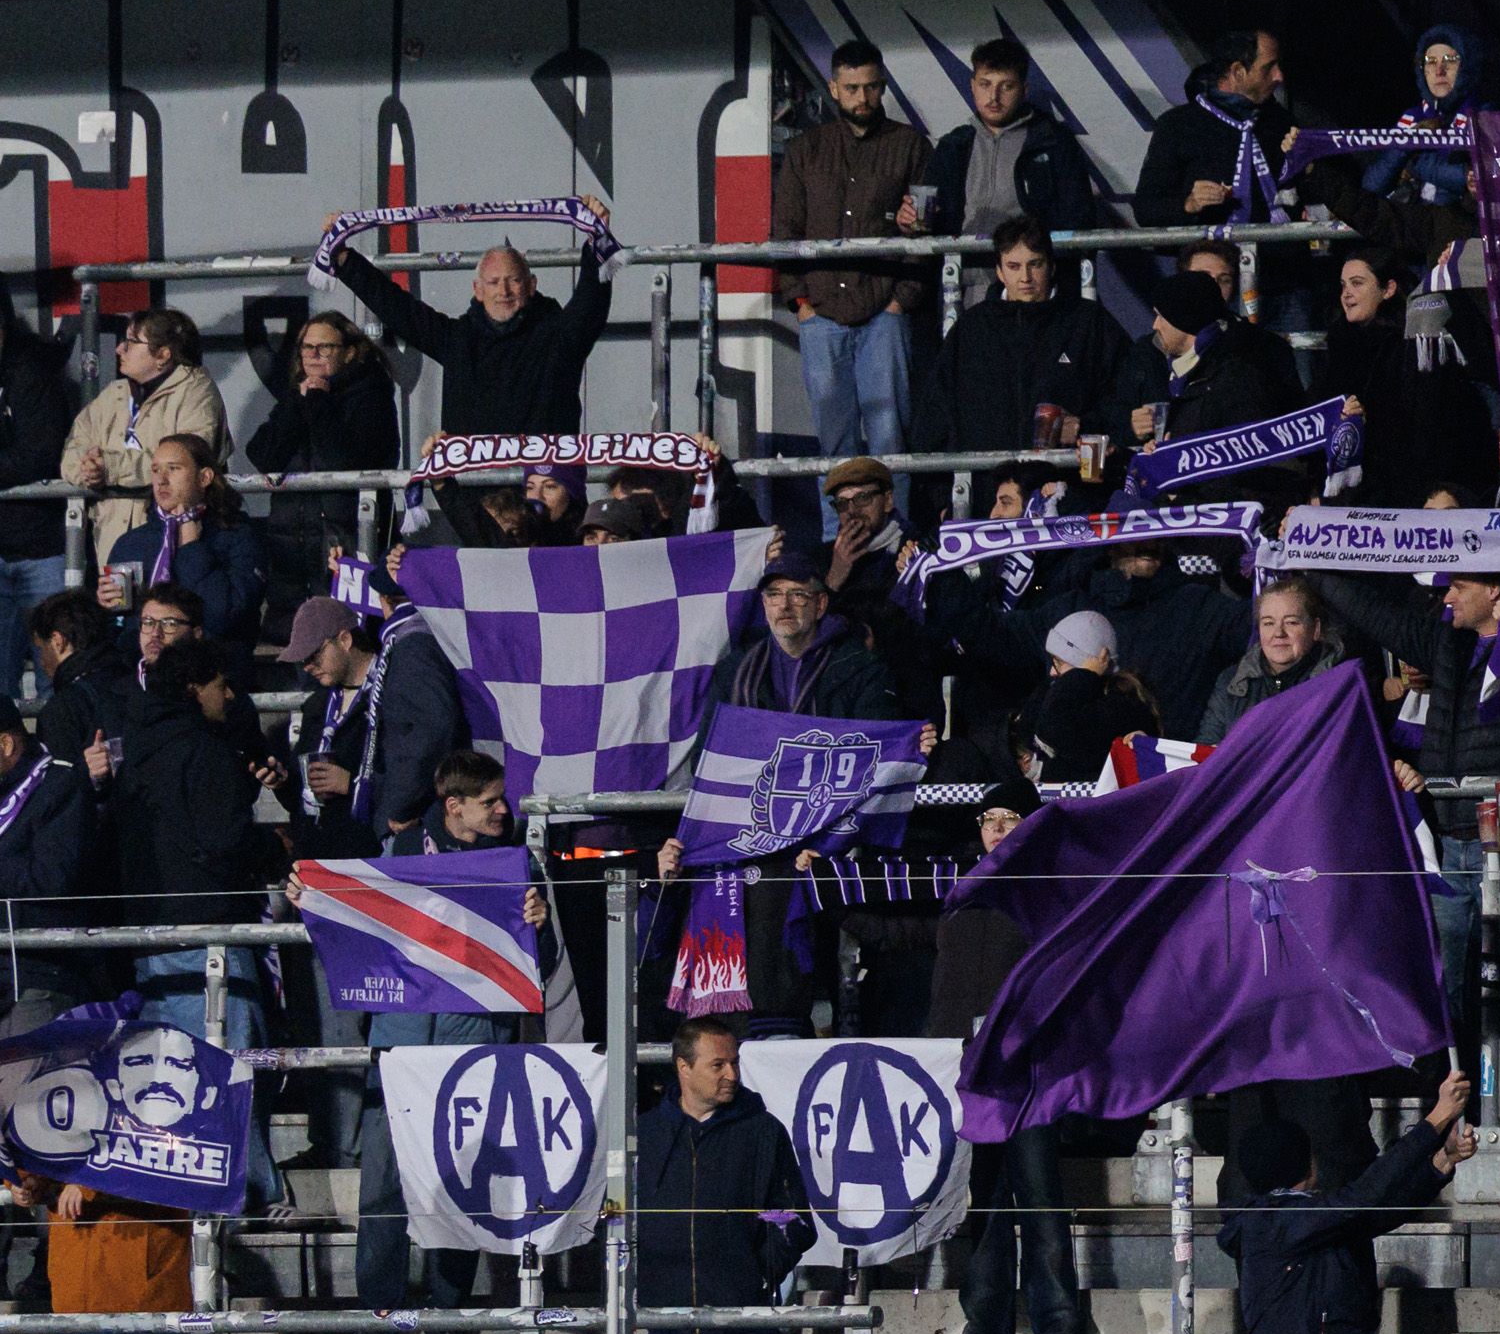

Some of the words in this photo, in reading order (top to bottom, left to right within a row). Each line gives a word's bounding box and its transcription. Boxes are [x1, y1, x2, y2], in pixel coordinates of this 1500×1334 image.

[1177, 431, 1267, 473] AUSTRIA
[1277, 410, 1326, 449] WIEN
[936, 515, 1047, 561] OCH
[1287, 523, 1386, 550] AUSTRIA
[1393, 527, 1454, 550] WIEN
[1303, 551, 1336, 561] WOMEN
[1392, 554, 1425, 564] LEAGUE
[92, 1127, 229, 1184] JAHRE
